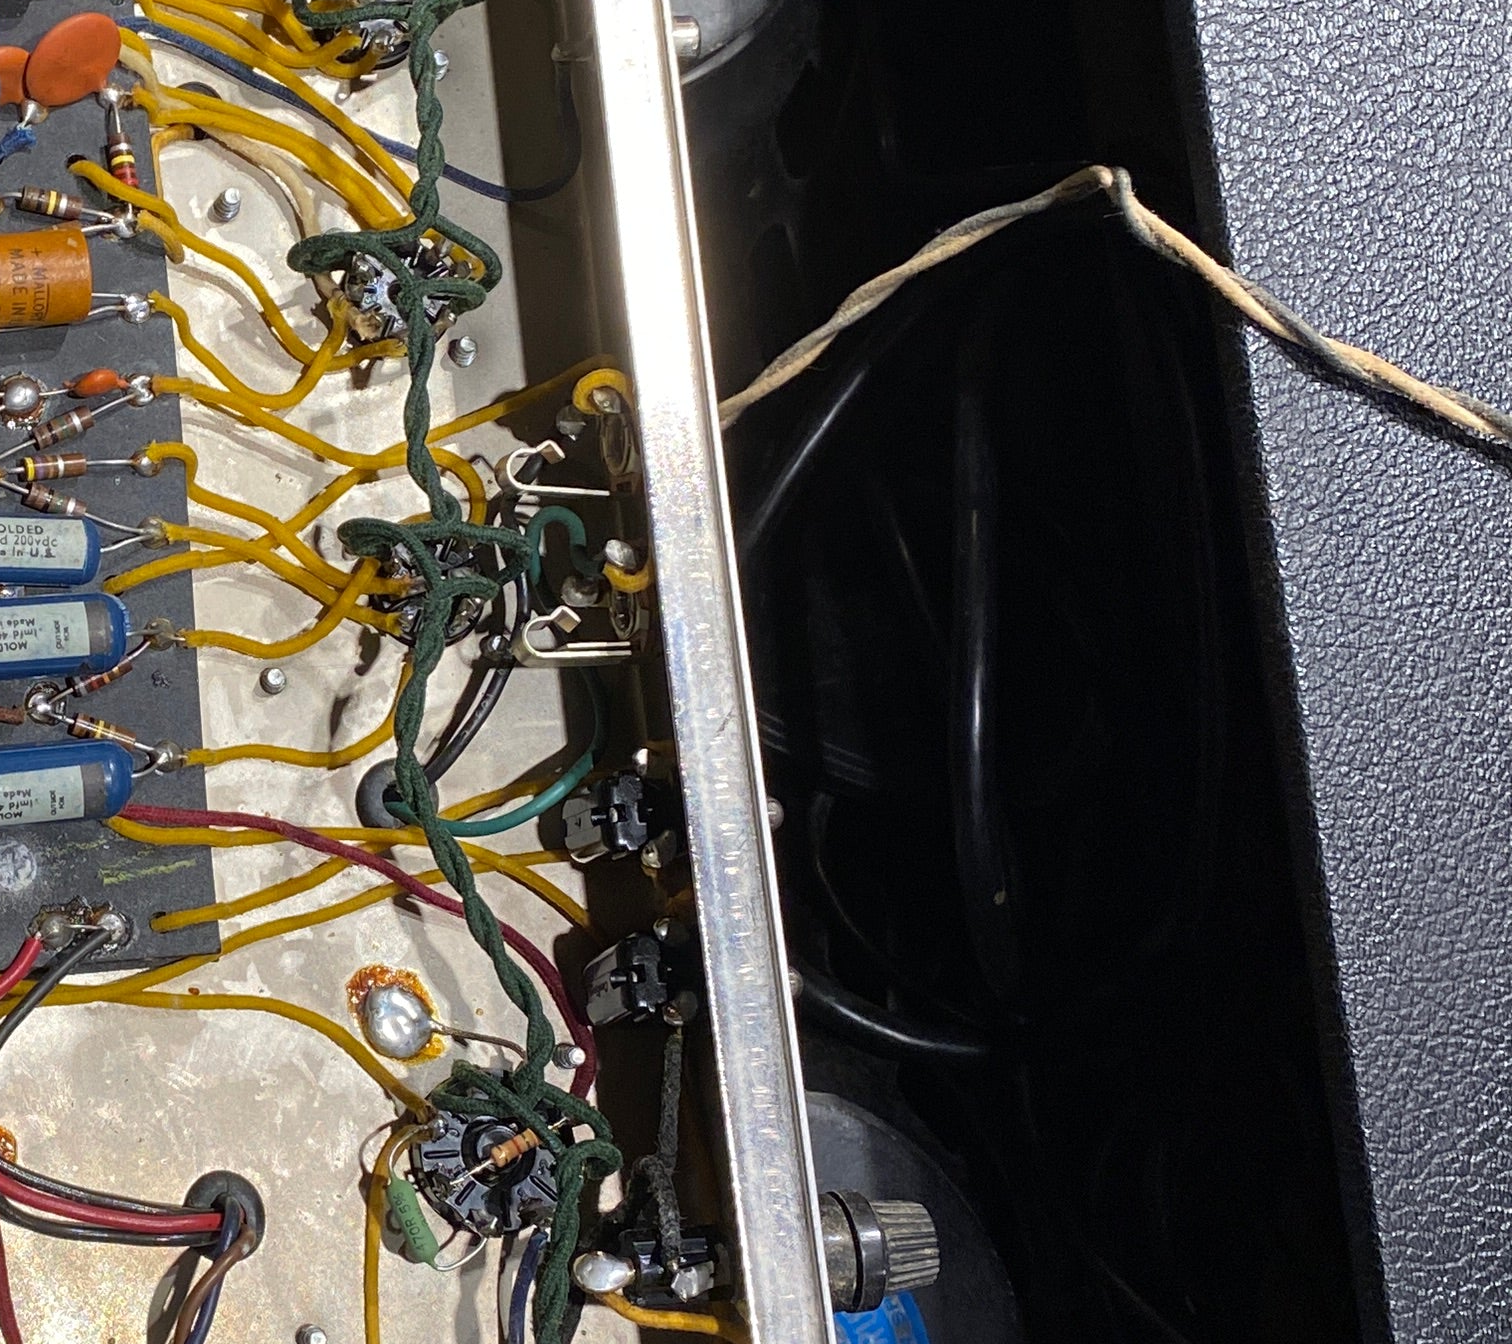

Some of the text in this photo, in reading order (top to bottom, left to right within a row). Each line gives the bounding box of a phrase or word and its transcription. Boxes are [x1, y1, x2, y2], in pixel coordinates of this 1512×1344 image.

[8, 248, 28, 316] MADE IN
[14, 535, 58, 547] 200vdc
[6, 618, 35, 627] Made
[3, 788, 31, 800] Made
